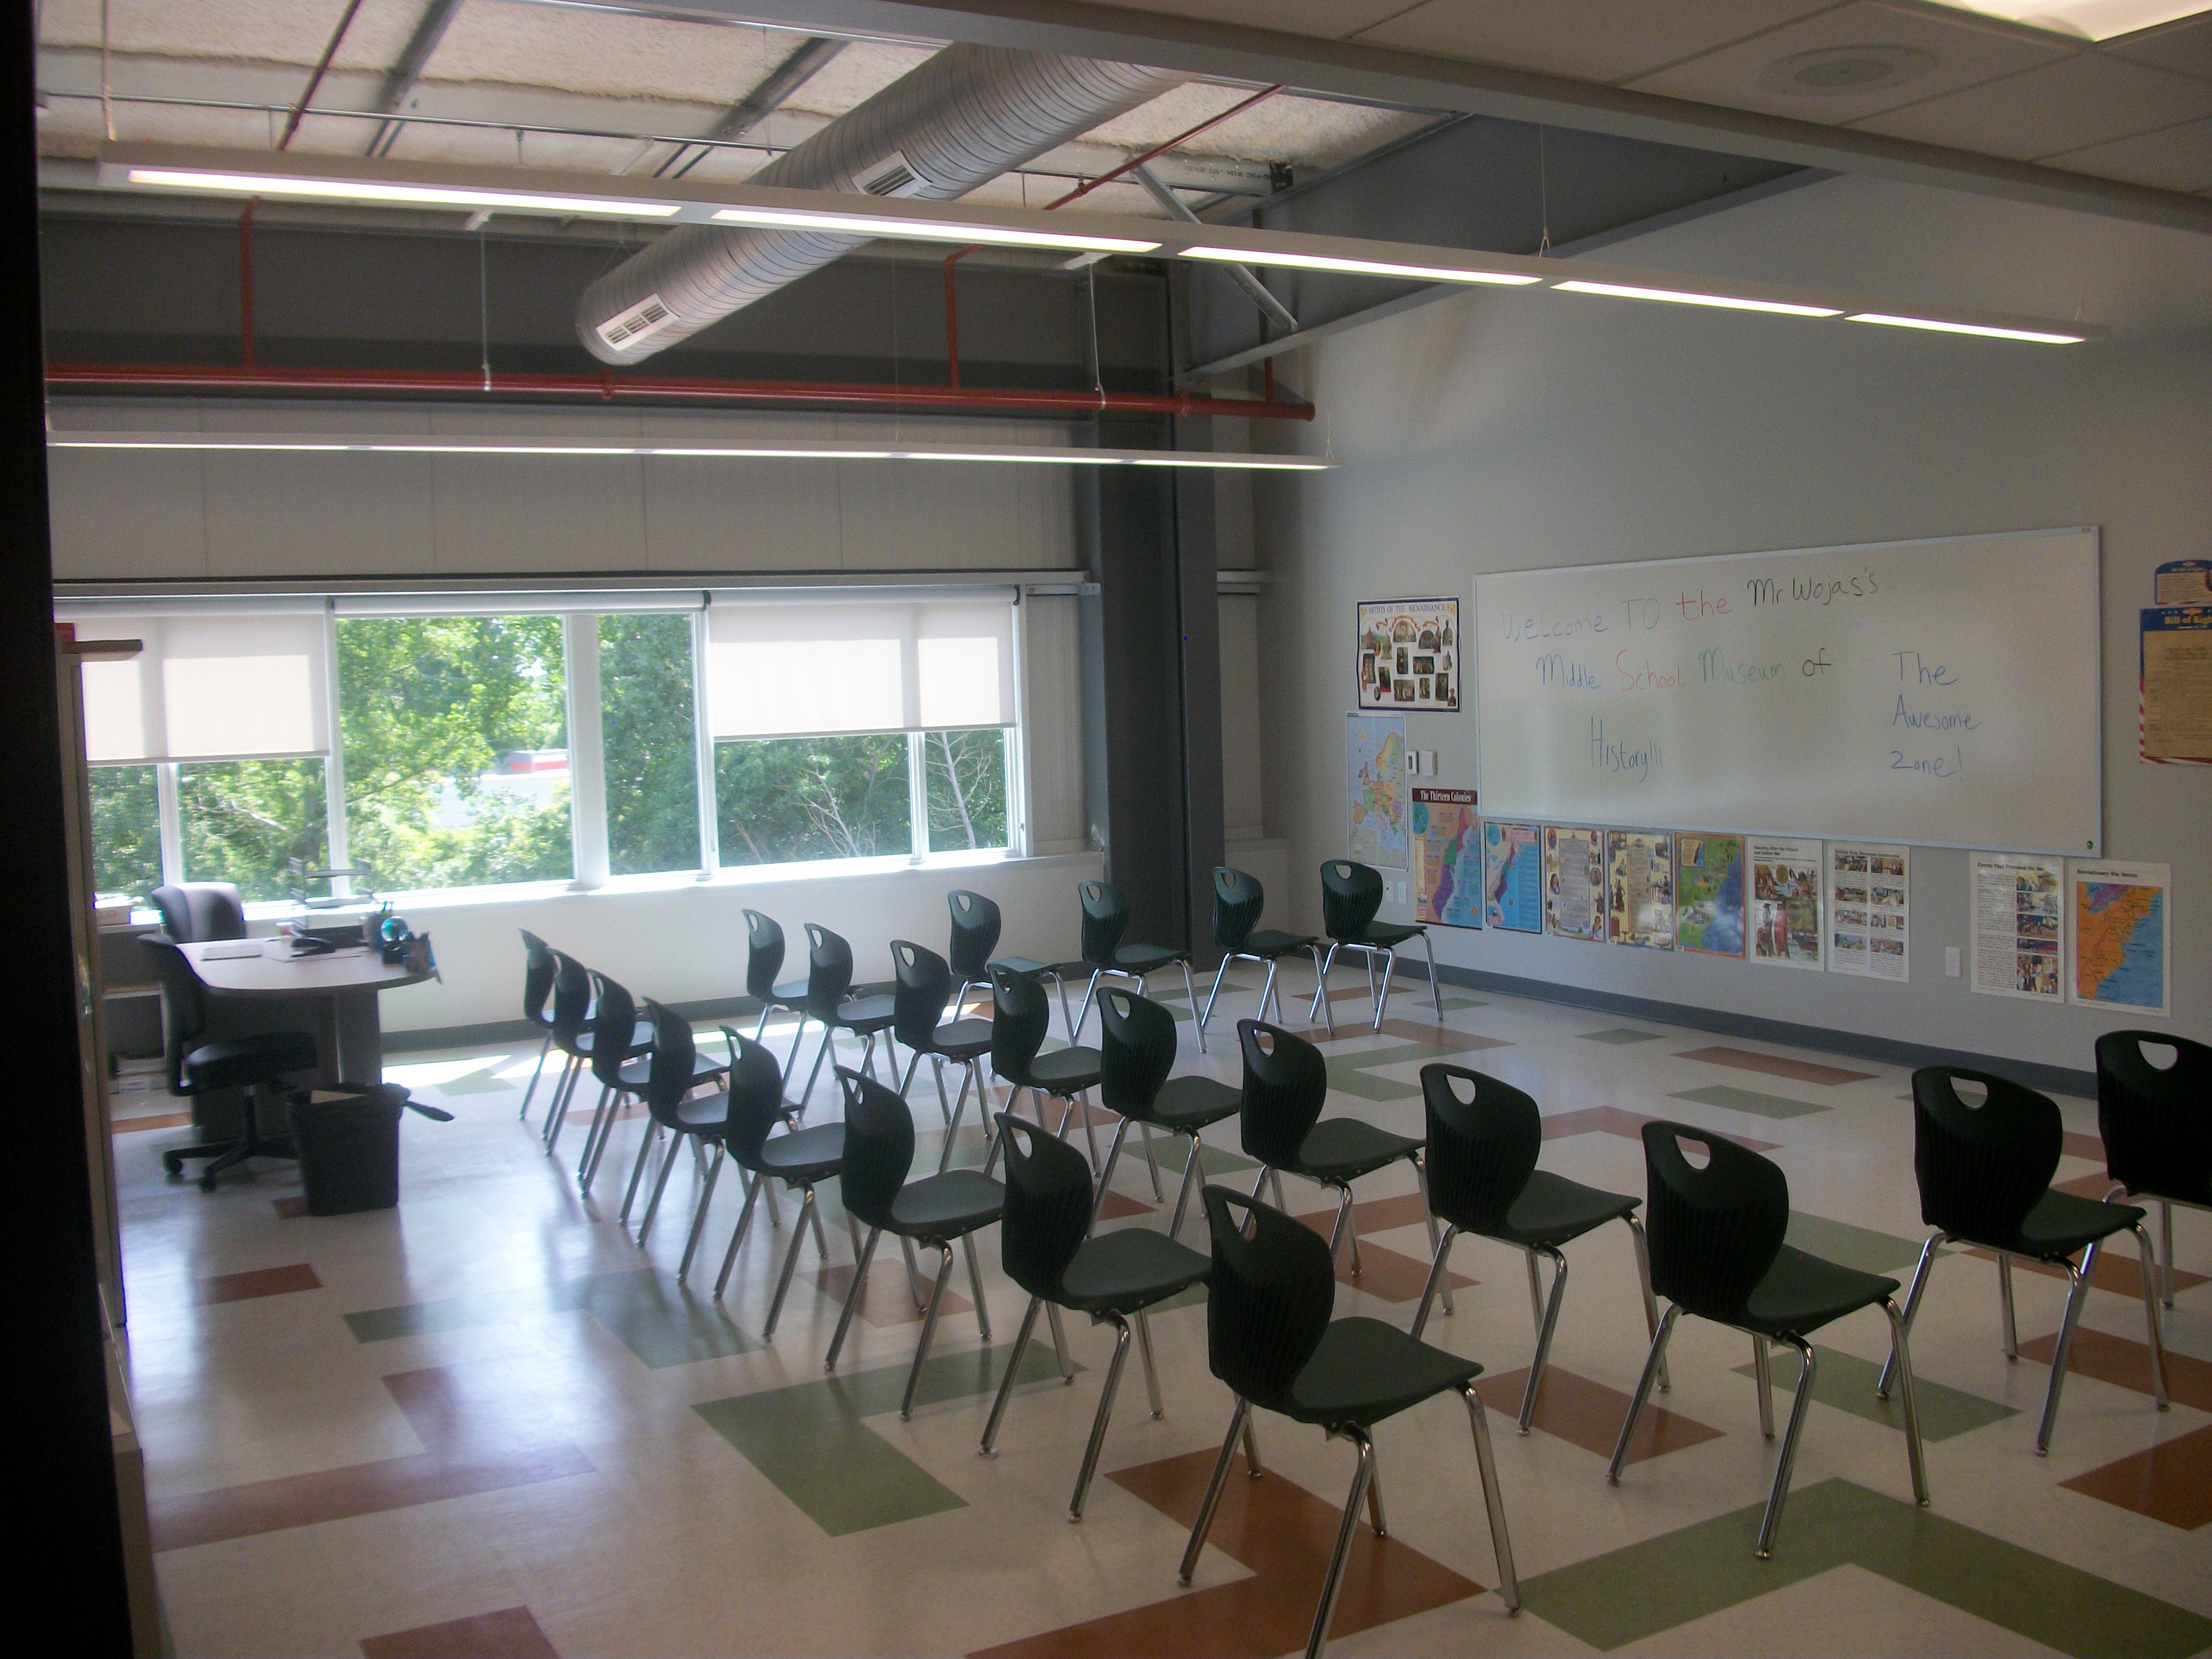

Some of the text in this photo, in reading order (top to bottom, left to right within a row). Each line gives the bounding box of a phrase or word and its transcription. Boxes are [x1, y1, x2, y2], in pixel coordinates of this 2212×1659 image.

[1387, 605, 1393, 613] OF
[1396, 604, 1405, 613] THE
[1408, 603, 1446, 612] RENAISSANCE
[1501, 611, 1609, 641] Welcome
[1674, 589, 1733, 621] the
[2182, 615, 2192, 624] of
[1536, 646, 1832, 691] Middle School Museum of
[1892, 651, 1958, 686] The
[1892, 693, 1981, 730] Awesome
[1420, 790, 1472, 803] The Thirteen Colonies
